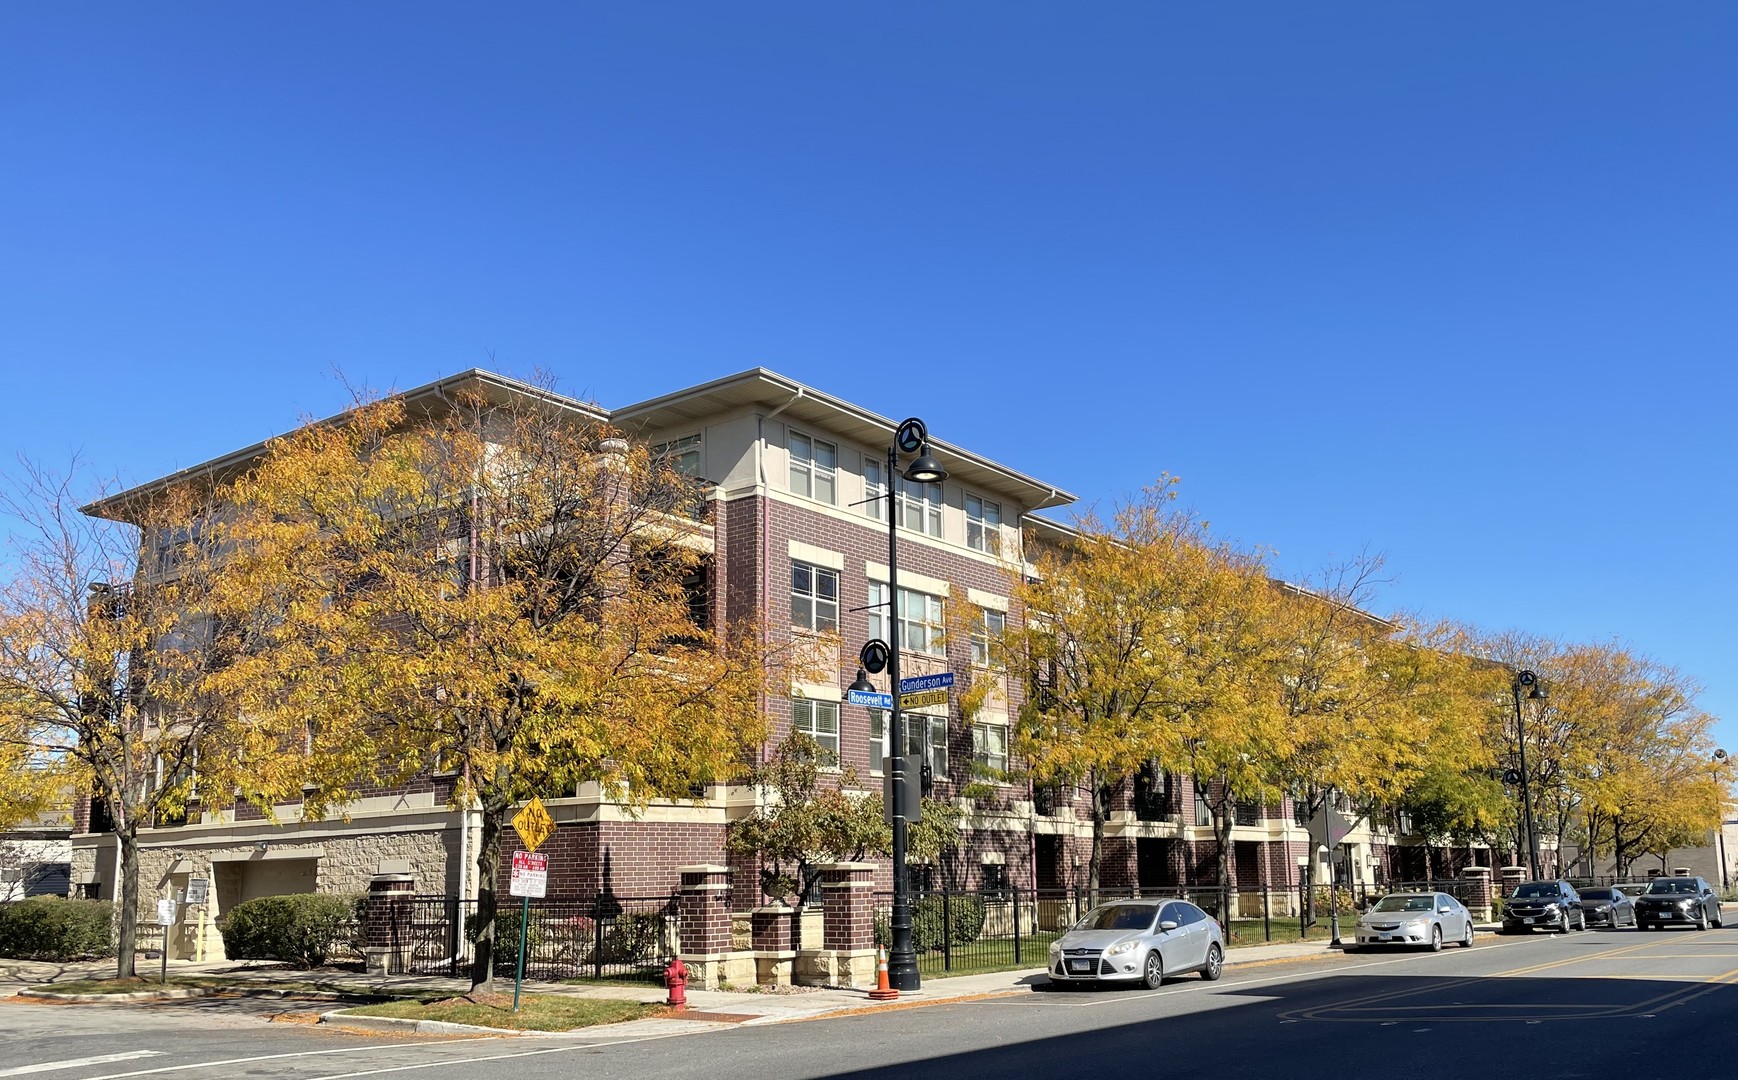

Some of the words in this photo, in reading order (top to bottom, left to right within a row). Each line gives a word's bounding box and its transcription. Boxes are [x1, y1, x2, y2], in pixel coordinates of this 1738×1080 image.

[902, 678, 940, 691] Gunderson
[941, 676, 952, 684] Ave
[850, 691, 883, 706] Roosevelt
[884, 697, 891, 705] Rd
[910, 696, 918, 705] NO
[922, 693, 945, 704] OUTLET
[529, 808, 542, 819] NO
[518, 820, 553, 834] OUTLET
[524, 853, 547, 862] PARKING
